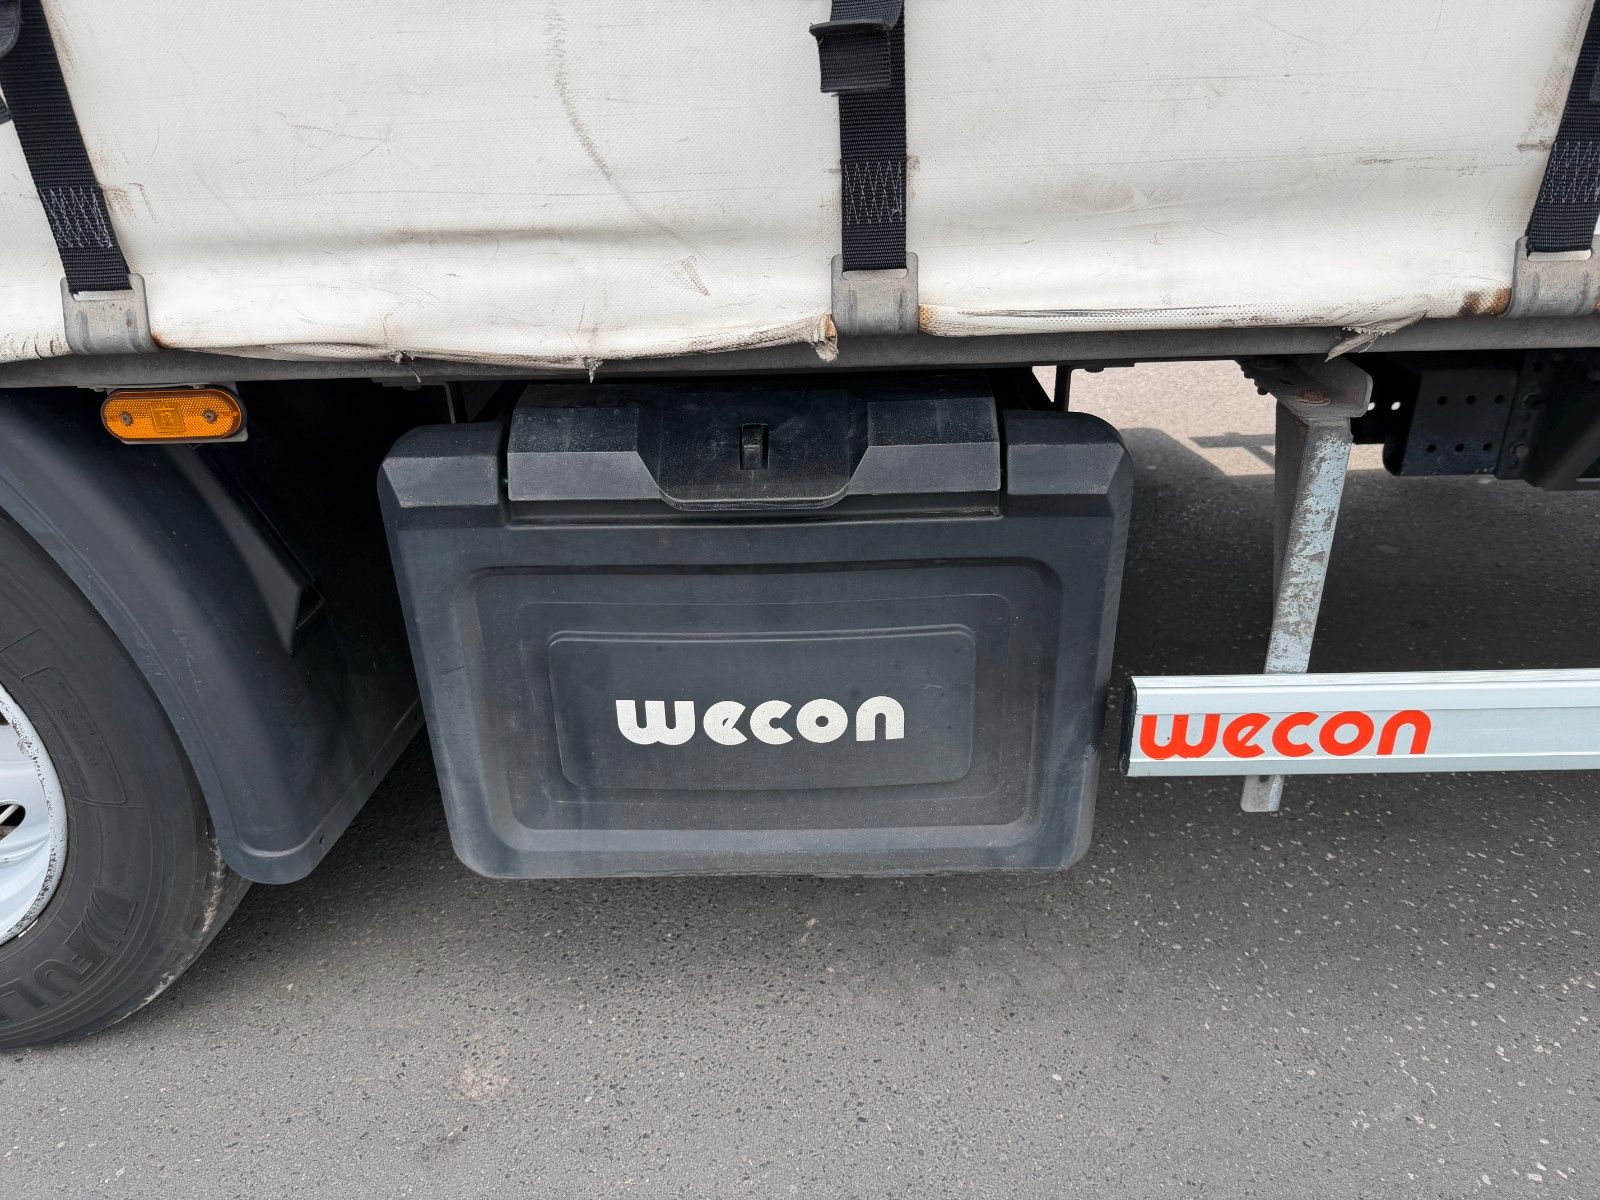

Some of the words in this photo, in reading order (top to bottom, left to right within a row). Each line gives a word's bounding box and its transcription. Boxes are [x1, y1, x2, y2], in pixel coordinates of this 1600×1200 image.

[616, 696, 905, 746] wecon
[1139, 709, 1432, 760] wecon
[0, 913, 110, 1022] FUL
